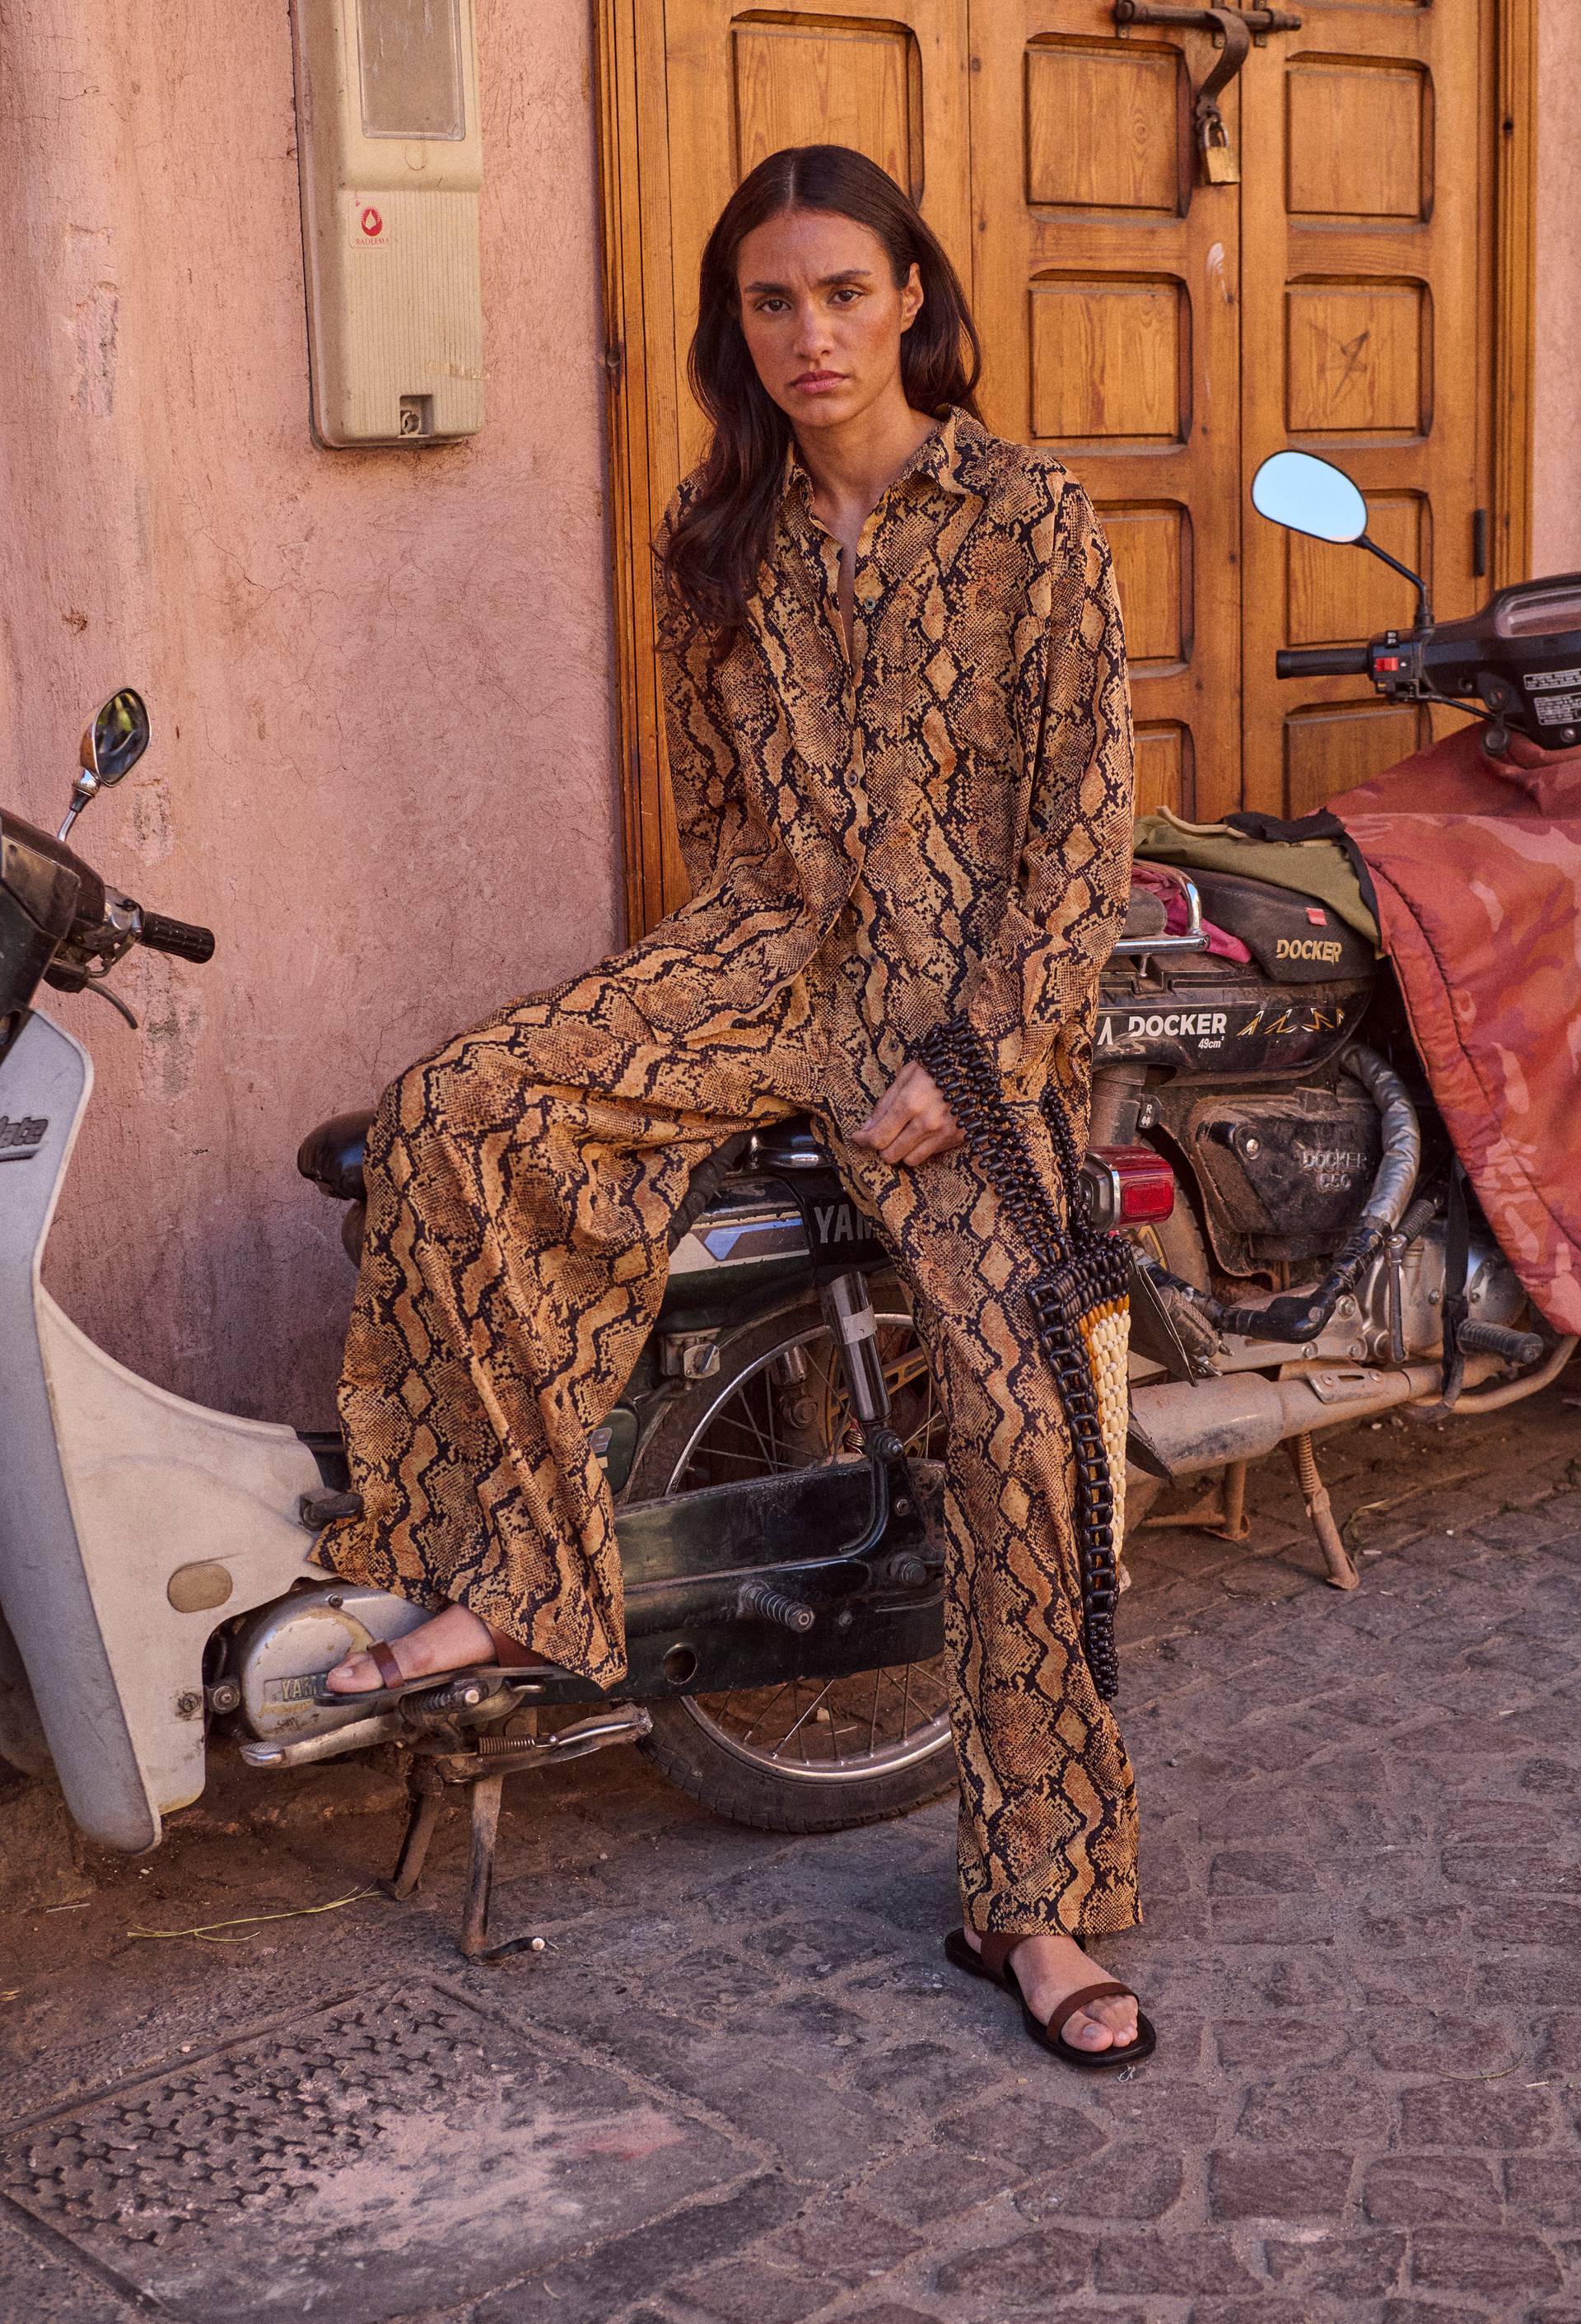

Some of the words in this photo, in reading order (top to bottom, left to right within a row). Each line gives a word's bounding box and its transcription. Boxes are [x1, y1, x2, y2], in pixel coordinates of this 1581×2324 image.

[1276, 939, 1343, 964] DOCKER
[1128, 1013, 1228, 1038] DOCKER
[1301, 1150, 1368, 1170] DOCKER
